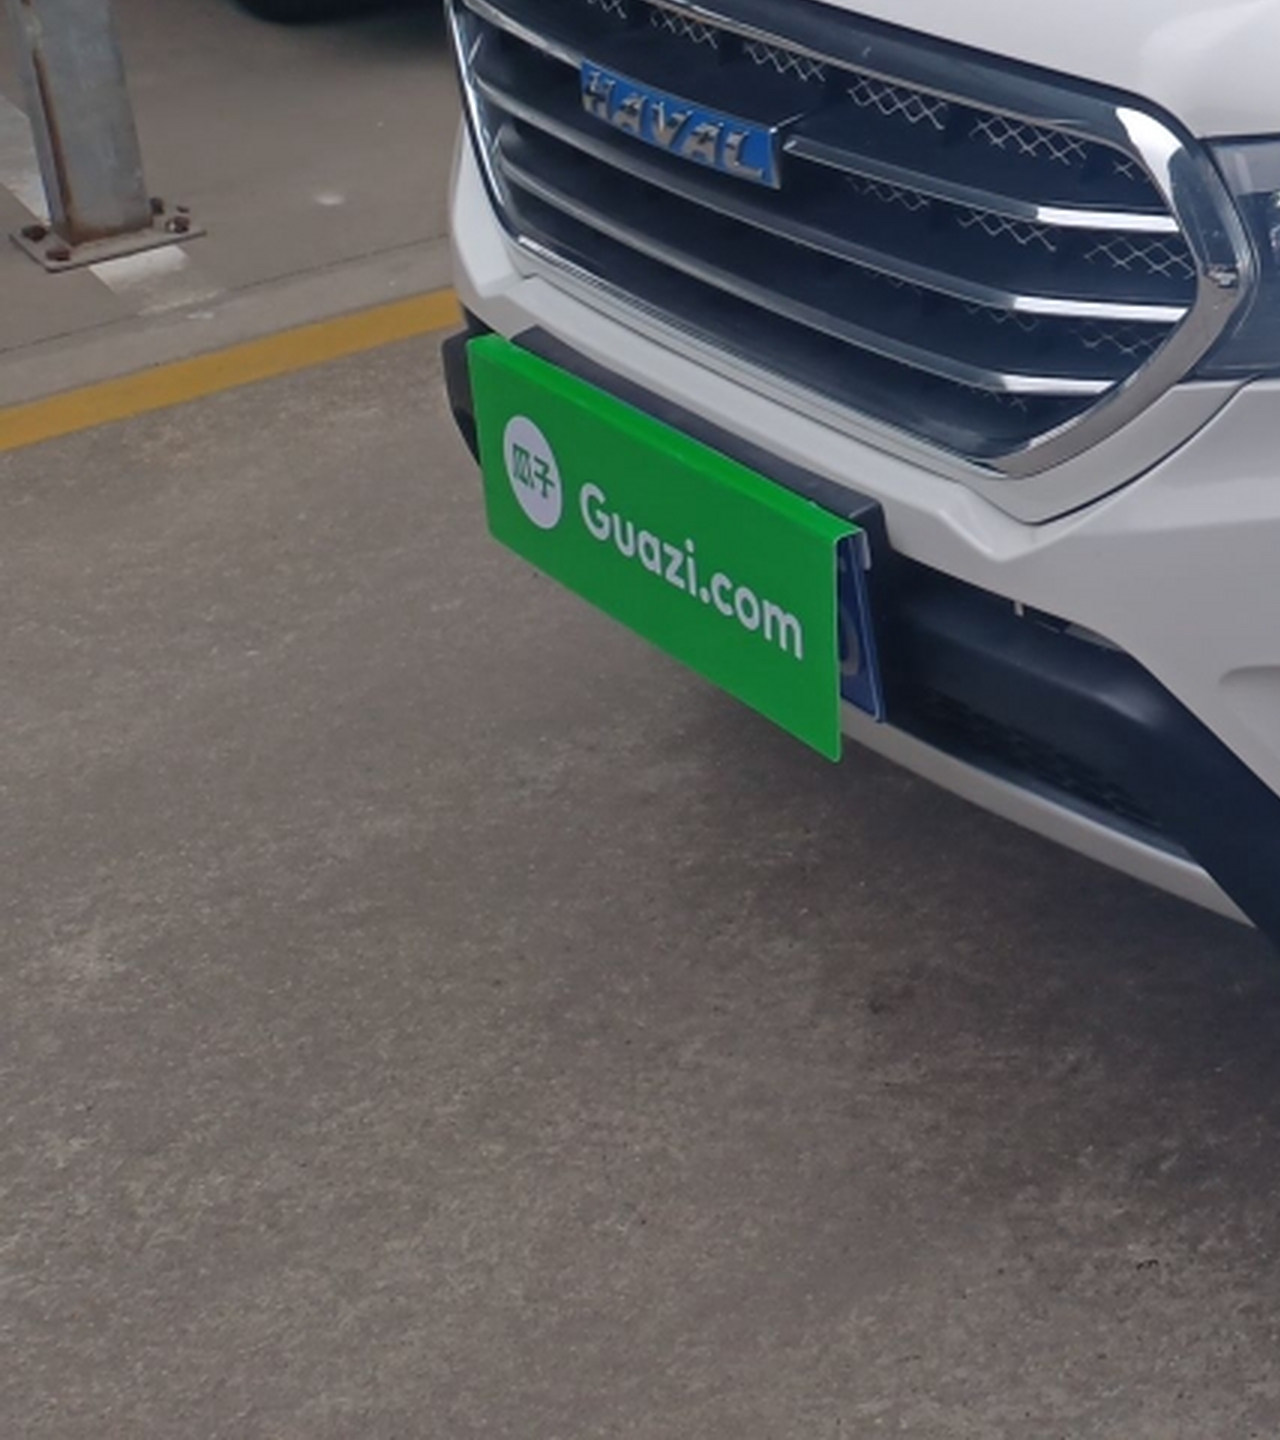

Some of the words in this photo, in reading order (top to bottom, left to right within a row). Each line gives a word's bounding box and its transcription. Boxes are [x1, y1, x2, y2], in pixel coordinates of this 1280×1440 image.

[584, 70, 764, 182] HAVAL
[512, 443, 556, 498] 瓜子
[579, 482, 804, 660] Guazi.com
